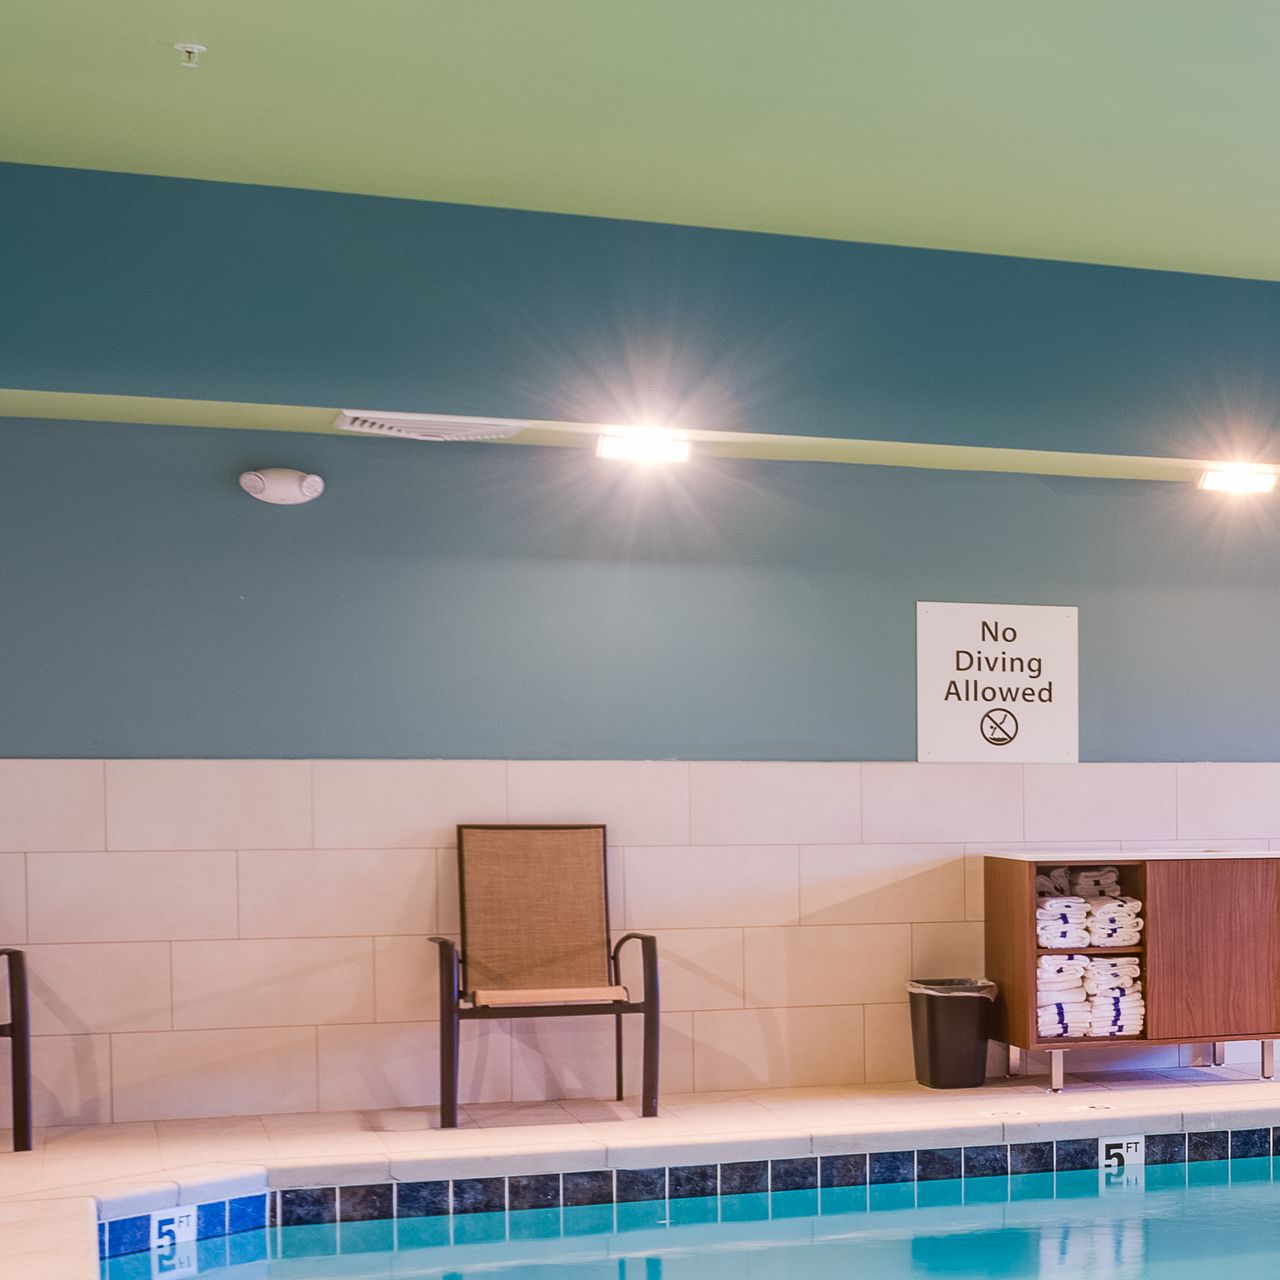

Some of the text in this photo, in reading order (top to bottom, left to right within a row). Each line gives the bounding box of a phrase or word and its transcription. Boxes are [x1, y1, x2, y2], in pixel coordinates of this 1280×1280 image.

[981, 621, 1017, 642] No
[956, 651, 1042, 678] Diving
[944, 680, 1053, 702] Allowed
